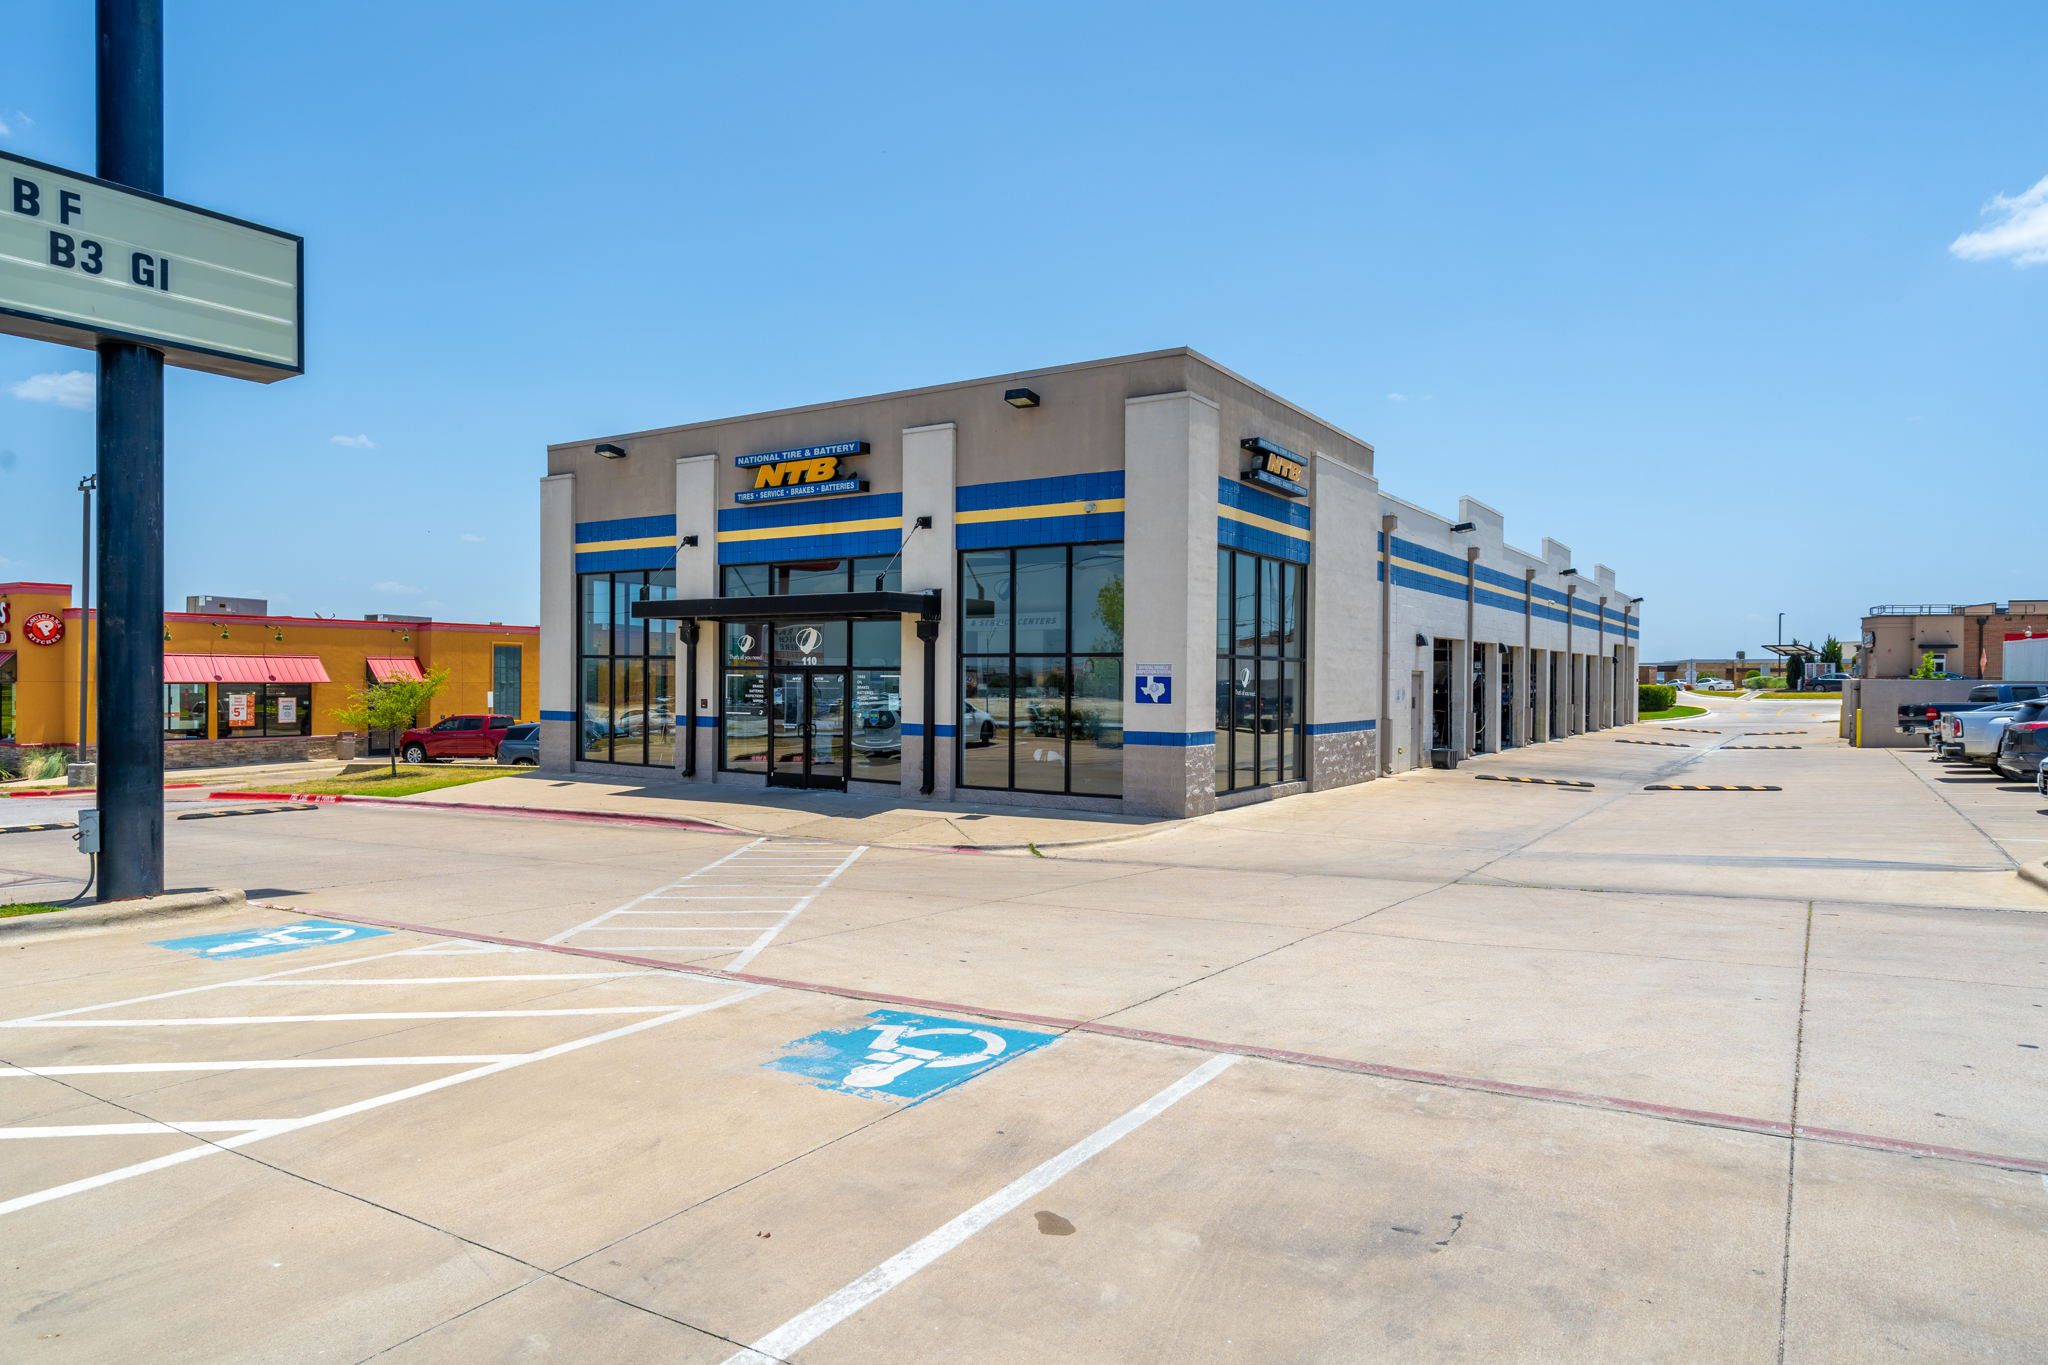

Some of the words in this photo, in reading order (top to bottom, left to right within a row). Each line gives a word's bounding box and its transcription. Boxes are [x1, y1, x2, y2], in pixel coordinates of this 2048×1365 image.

[13, 177, 40, 217] B
[60, 190, 81, 225] F
[50, 230, 103, 275] B3
[738, 453, 780, 465] NATIONAL
[782, 450, 802, 460] TIRE
[804, 449, 811, 457] &
[813, 443, 855, 456] BATTERY
[754, 456, 838, 488] NTB
[1267, 453, 1302, 482] NTB
[738, 493, 754, 501] TIRES
[760, 489, 785, 499] SERVICE
[790, 486, 815, 495] BRAKES
[821, 481, 855, 492] BATTERIES
[27, 614, 62, 629] LOUISIANA
[1017, 616, 1056, 625] CENTERS
[28, 632, 61, 645] KITCHEN
[801, 656, 817, 666] 110
